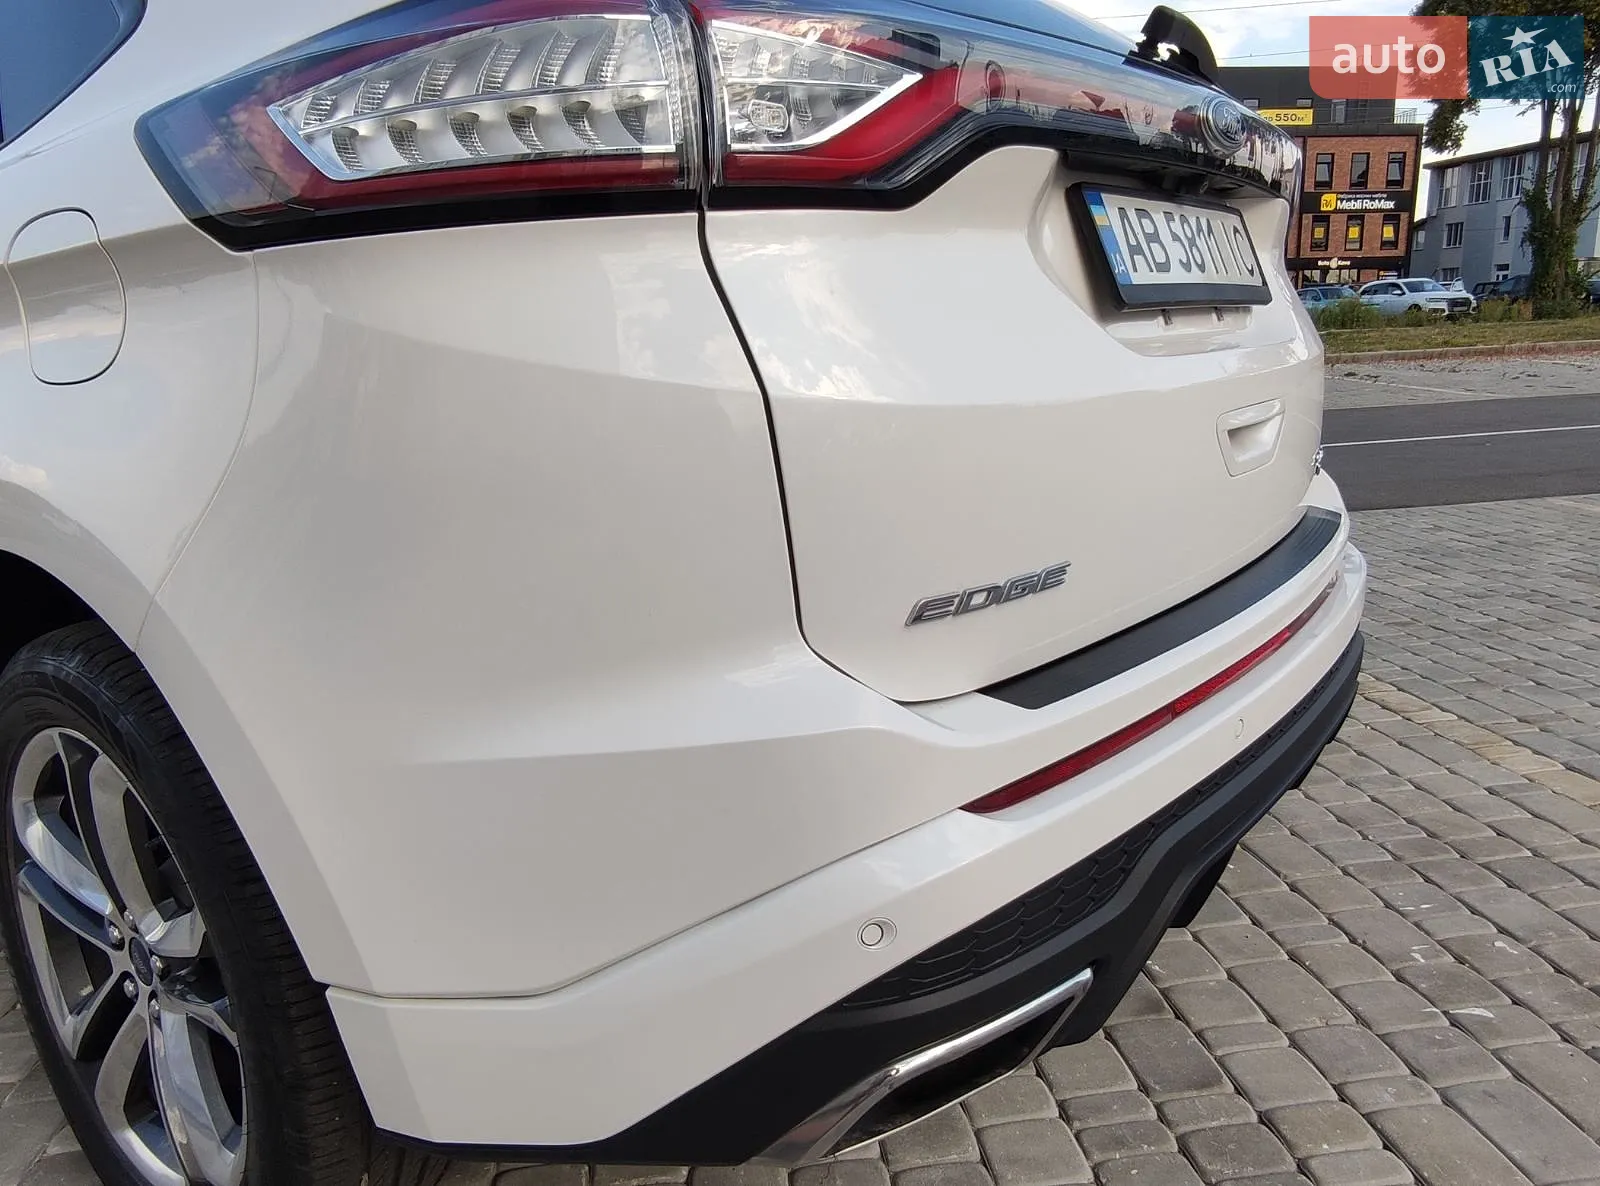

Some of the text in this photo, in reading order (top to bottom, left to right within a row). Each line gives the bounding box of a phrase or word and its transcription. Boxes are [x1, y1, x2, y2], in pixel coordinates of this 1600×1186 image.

[1337, 199, 1395, 210] Mebli RoMax
[1117, 207, 1171, 273] AB
[1163, 211, 1228, 275] 5811
[1220, 220, 1255, 277] IC
[904, 560, 1071, 627] EDGE
